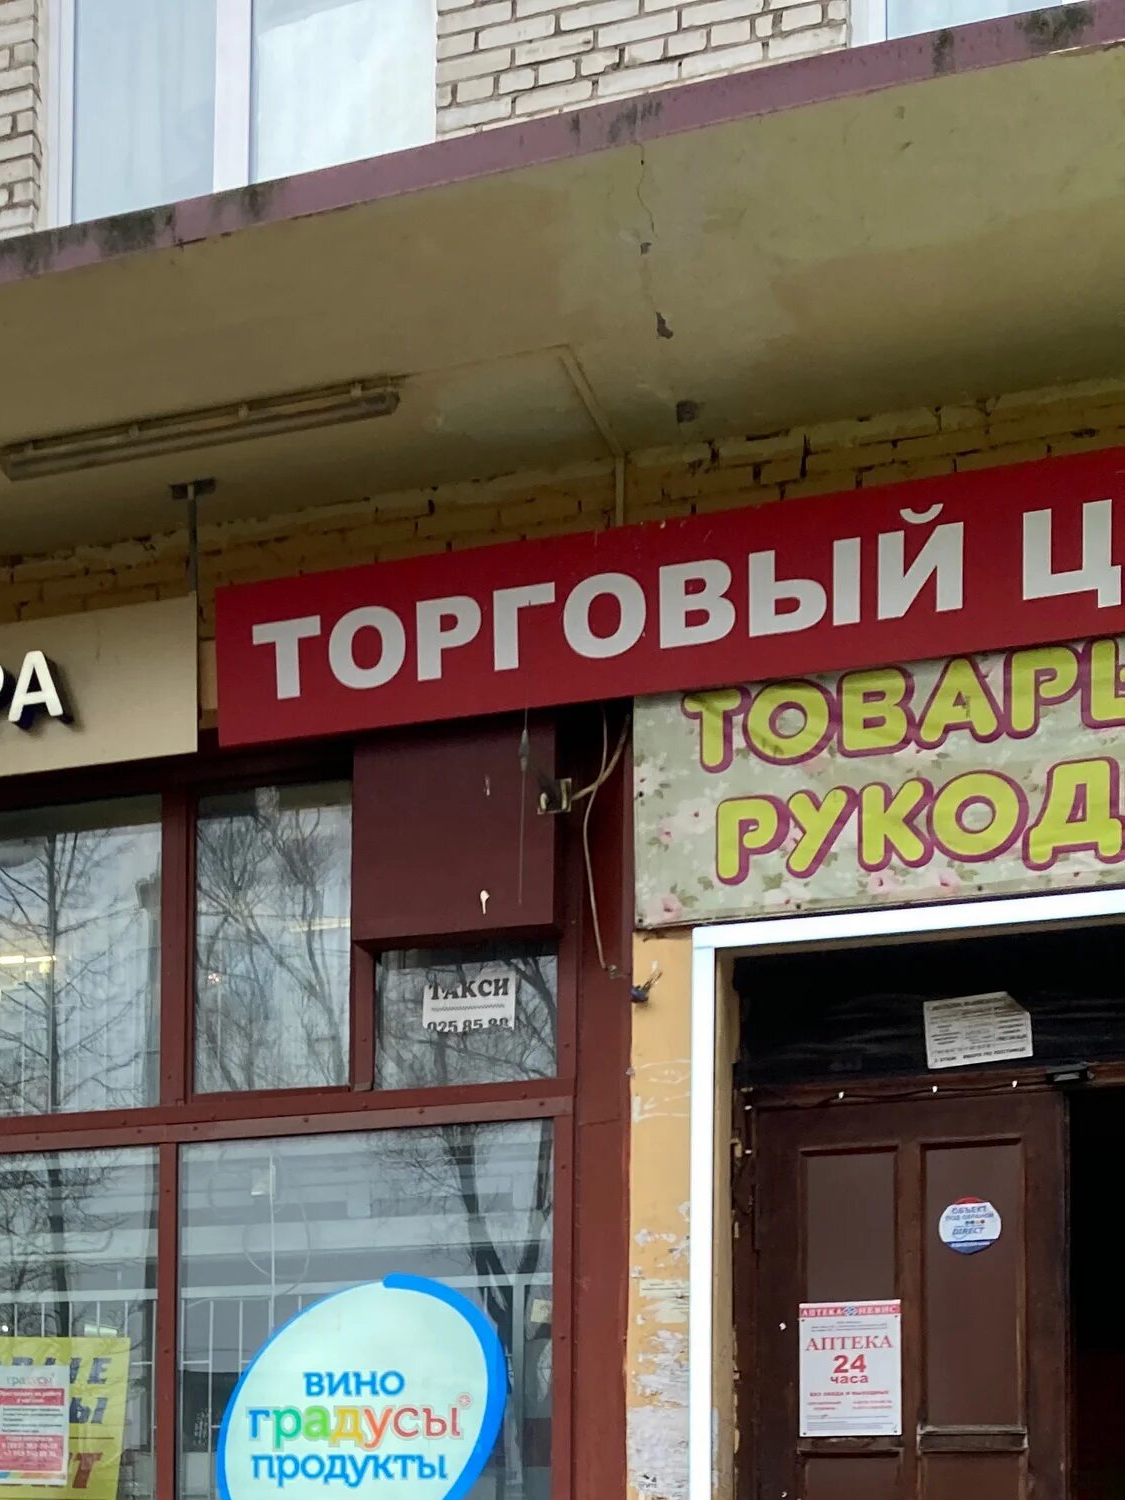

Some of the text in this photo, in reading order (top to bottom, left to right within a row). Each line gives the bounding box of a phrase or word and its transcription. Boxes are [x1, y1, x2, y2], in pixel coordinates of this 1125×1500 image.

[252, 502, 965, 701] ТОРГОВЫЙ
[714, 757, 1125, 886] РУКОД
[805, 1334, 894, 1352] АПТЕКА
[829, 1374, 869, 1385] часа
[833, 1353, 867, 1374] 24
[248, 1404, 462, 1451] градусы
[251, 1454, 448, 1489] продукты
